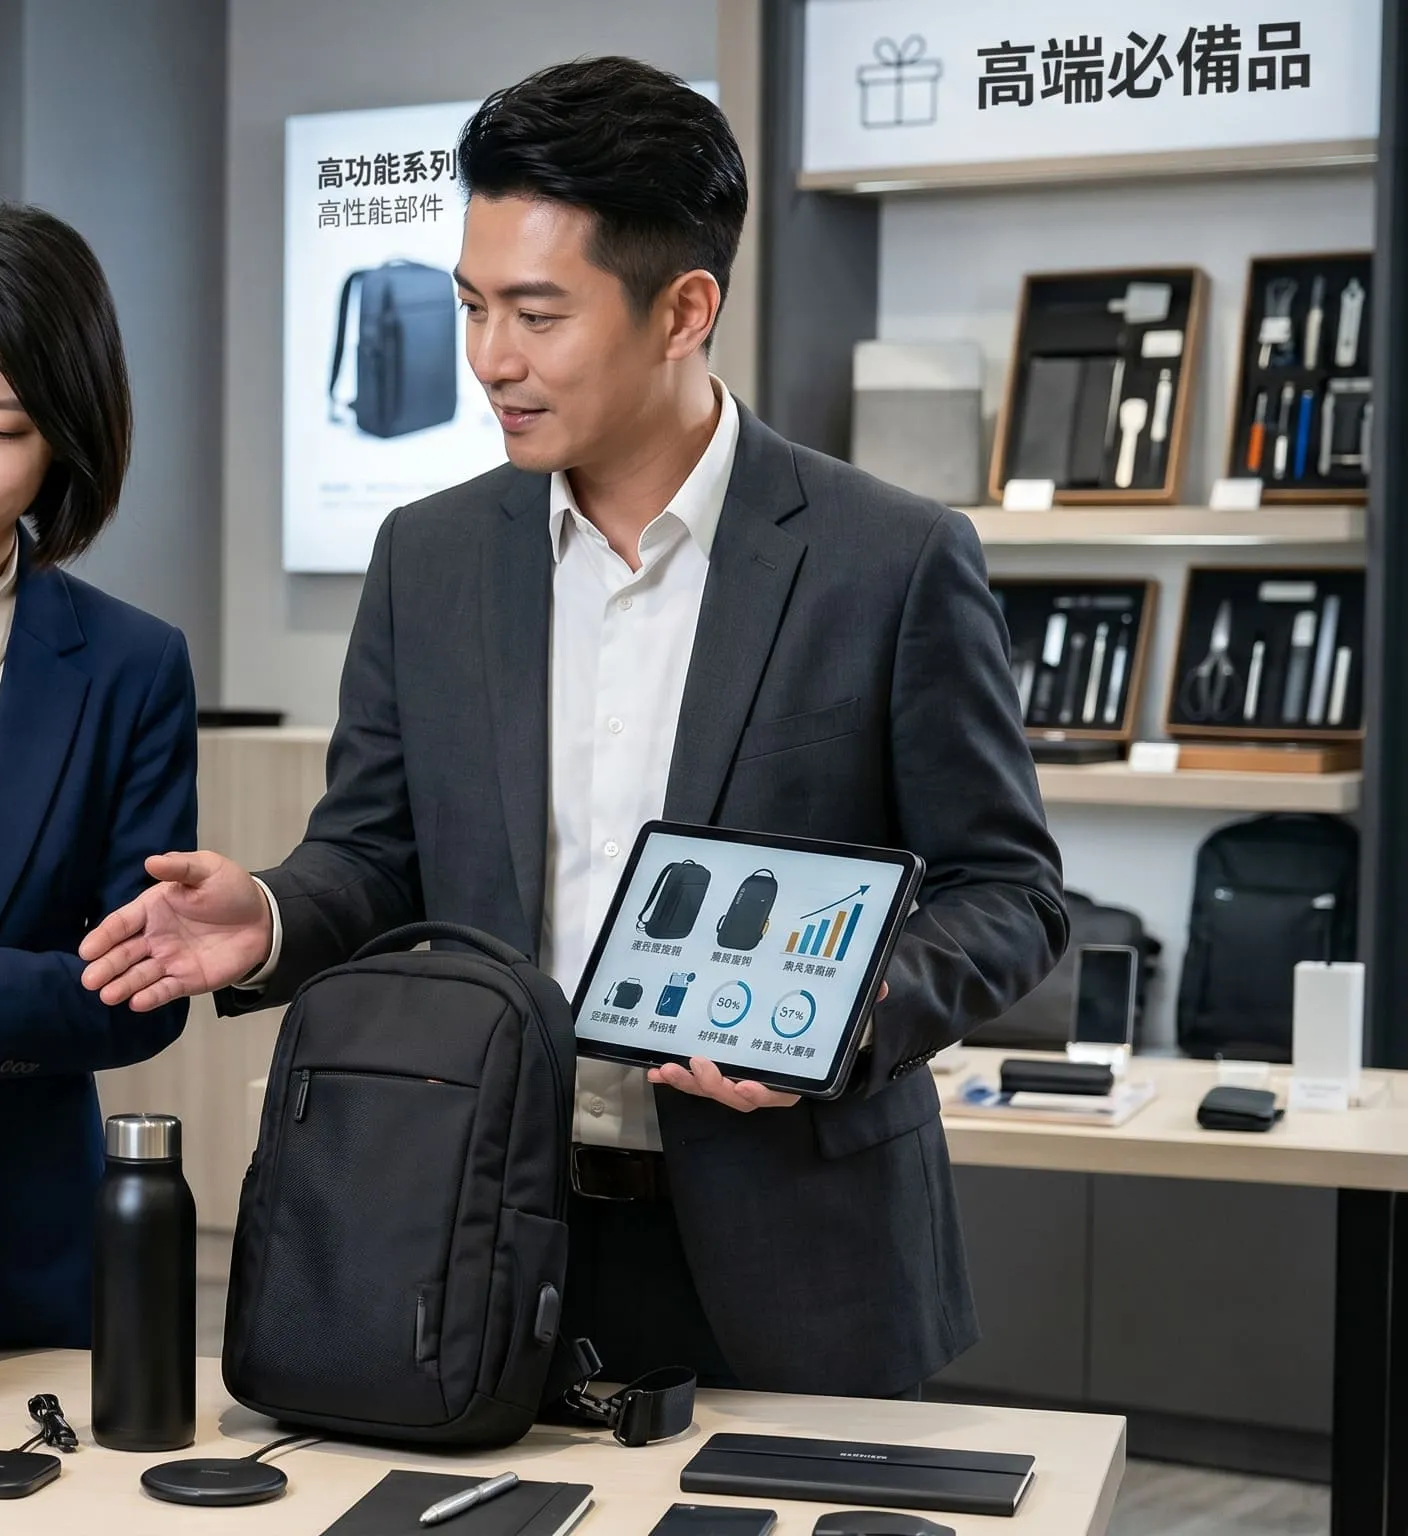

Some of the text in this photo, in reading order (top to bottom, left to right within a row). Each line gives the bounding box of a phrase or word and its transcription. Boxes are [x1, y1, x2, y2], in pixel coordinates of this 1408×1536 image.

[977, 21, 1312, 110] 高端必備品
[317, 148, 457, 190] 高功能系列
[317, 193, 444, 229] 高性能部件
